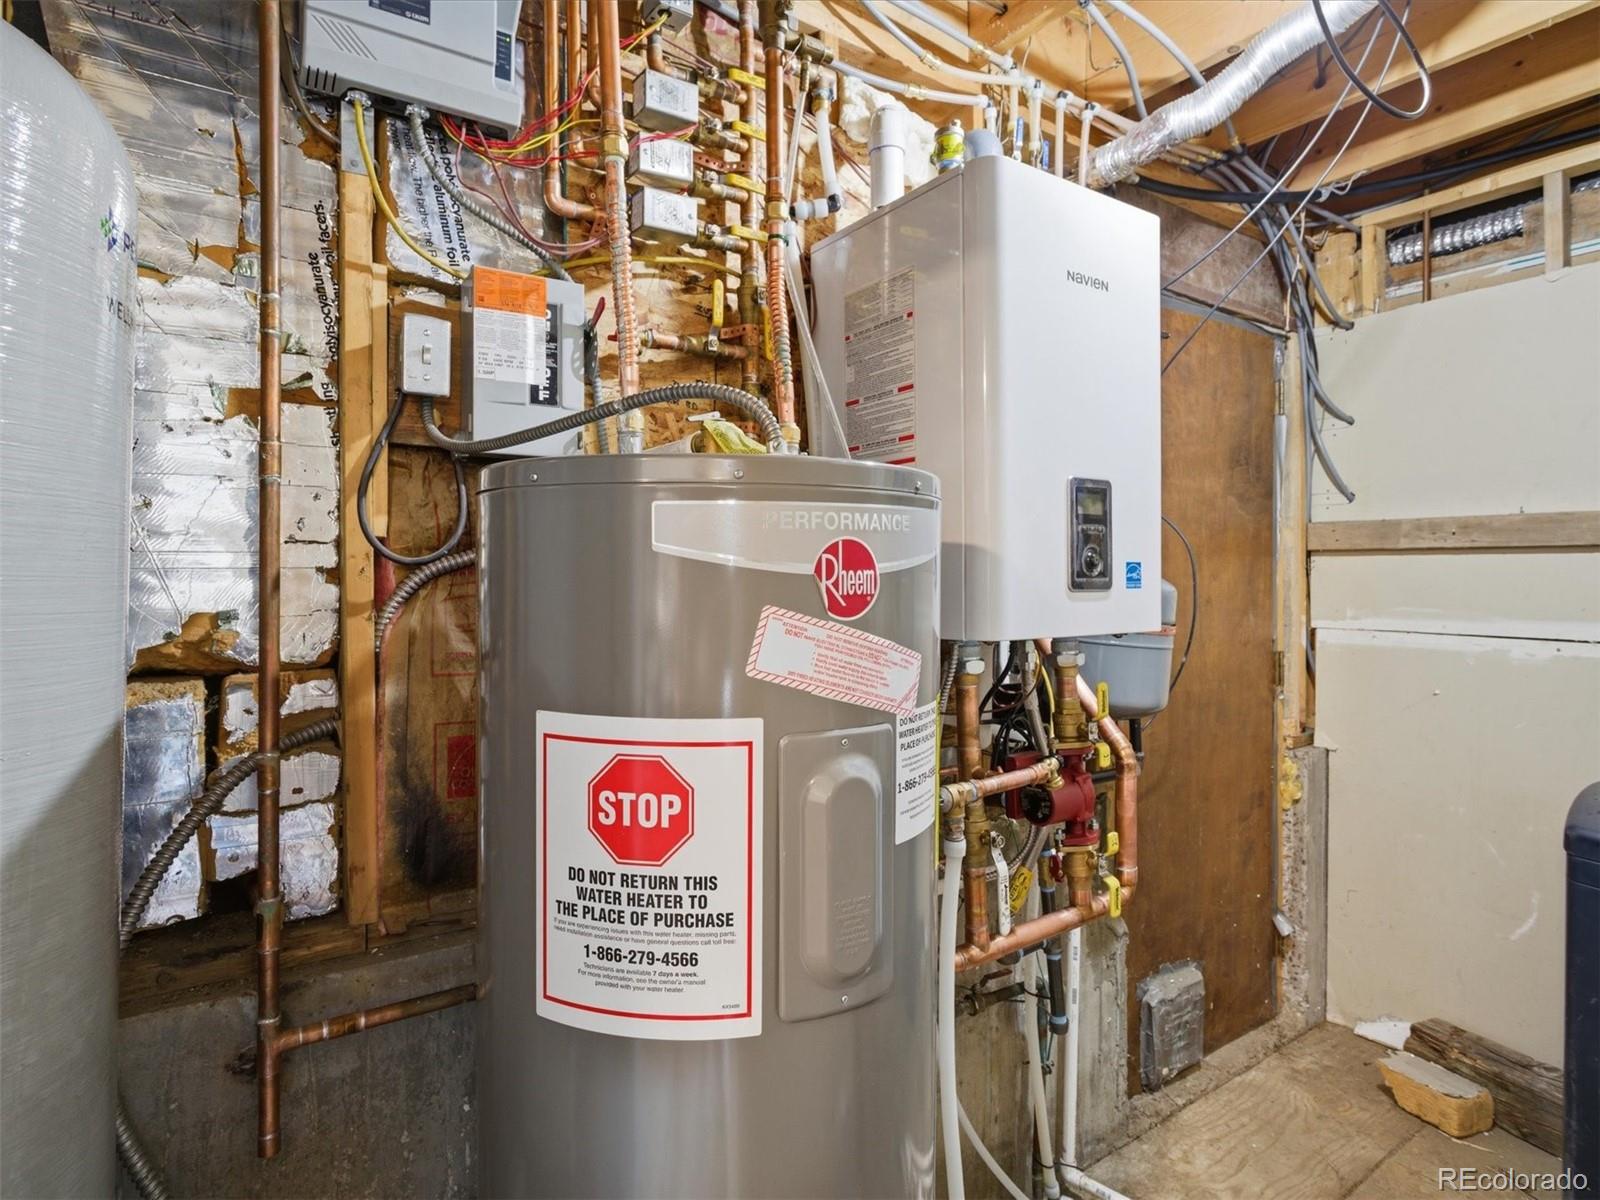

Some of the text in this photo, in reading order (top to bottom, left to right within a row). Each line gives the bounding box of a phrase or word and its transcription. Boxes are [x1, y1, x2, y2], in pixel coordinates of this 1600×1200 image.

[434, 186, 454, 244] aluminum
[446, 246, 460, 267] foil
[762, 511, 912, 532] PERFORMANCE
[821, 540, 875, 607] Rheem
[598, 790, 682, 829] STOP
[568, 866, 718, 892] DO NOT RETURN THIS
[576, 886, 708, 910] WATER HEATER TO
[556, 900, 734, 928] THE PLACE OF PURCHASE
[584, 944, 699, 967] 1-866-279-4566
[658, 970, 674, 978] days
